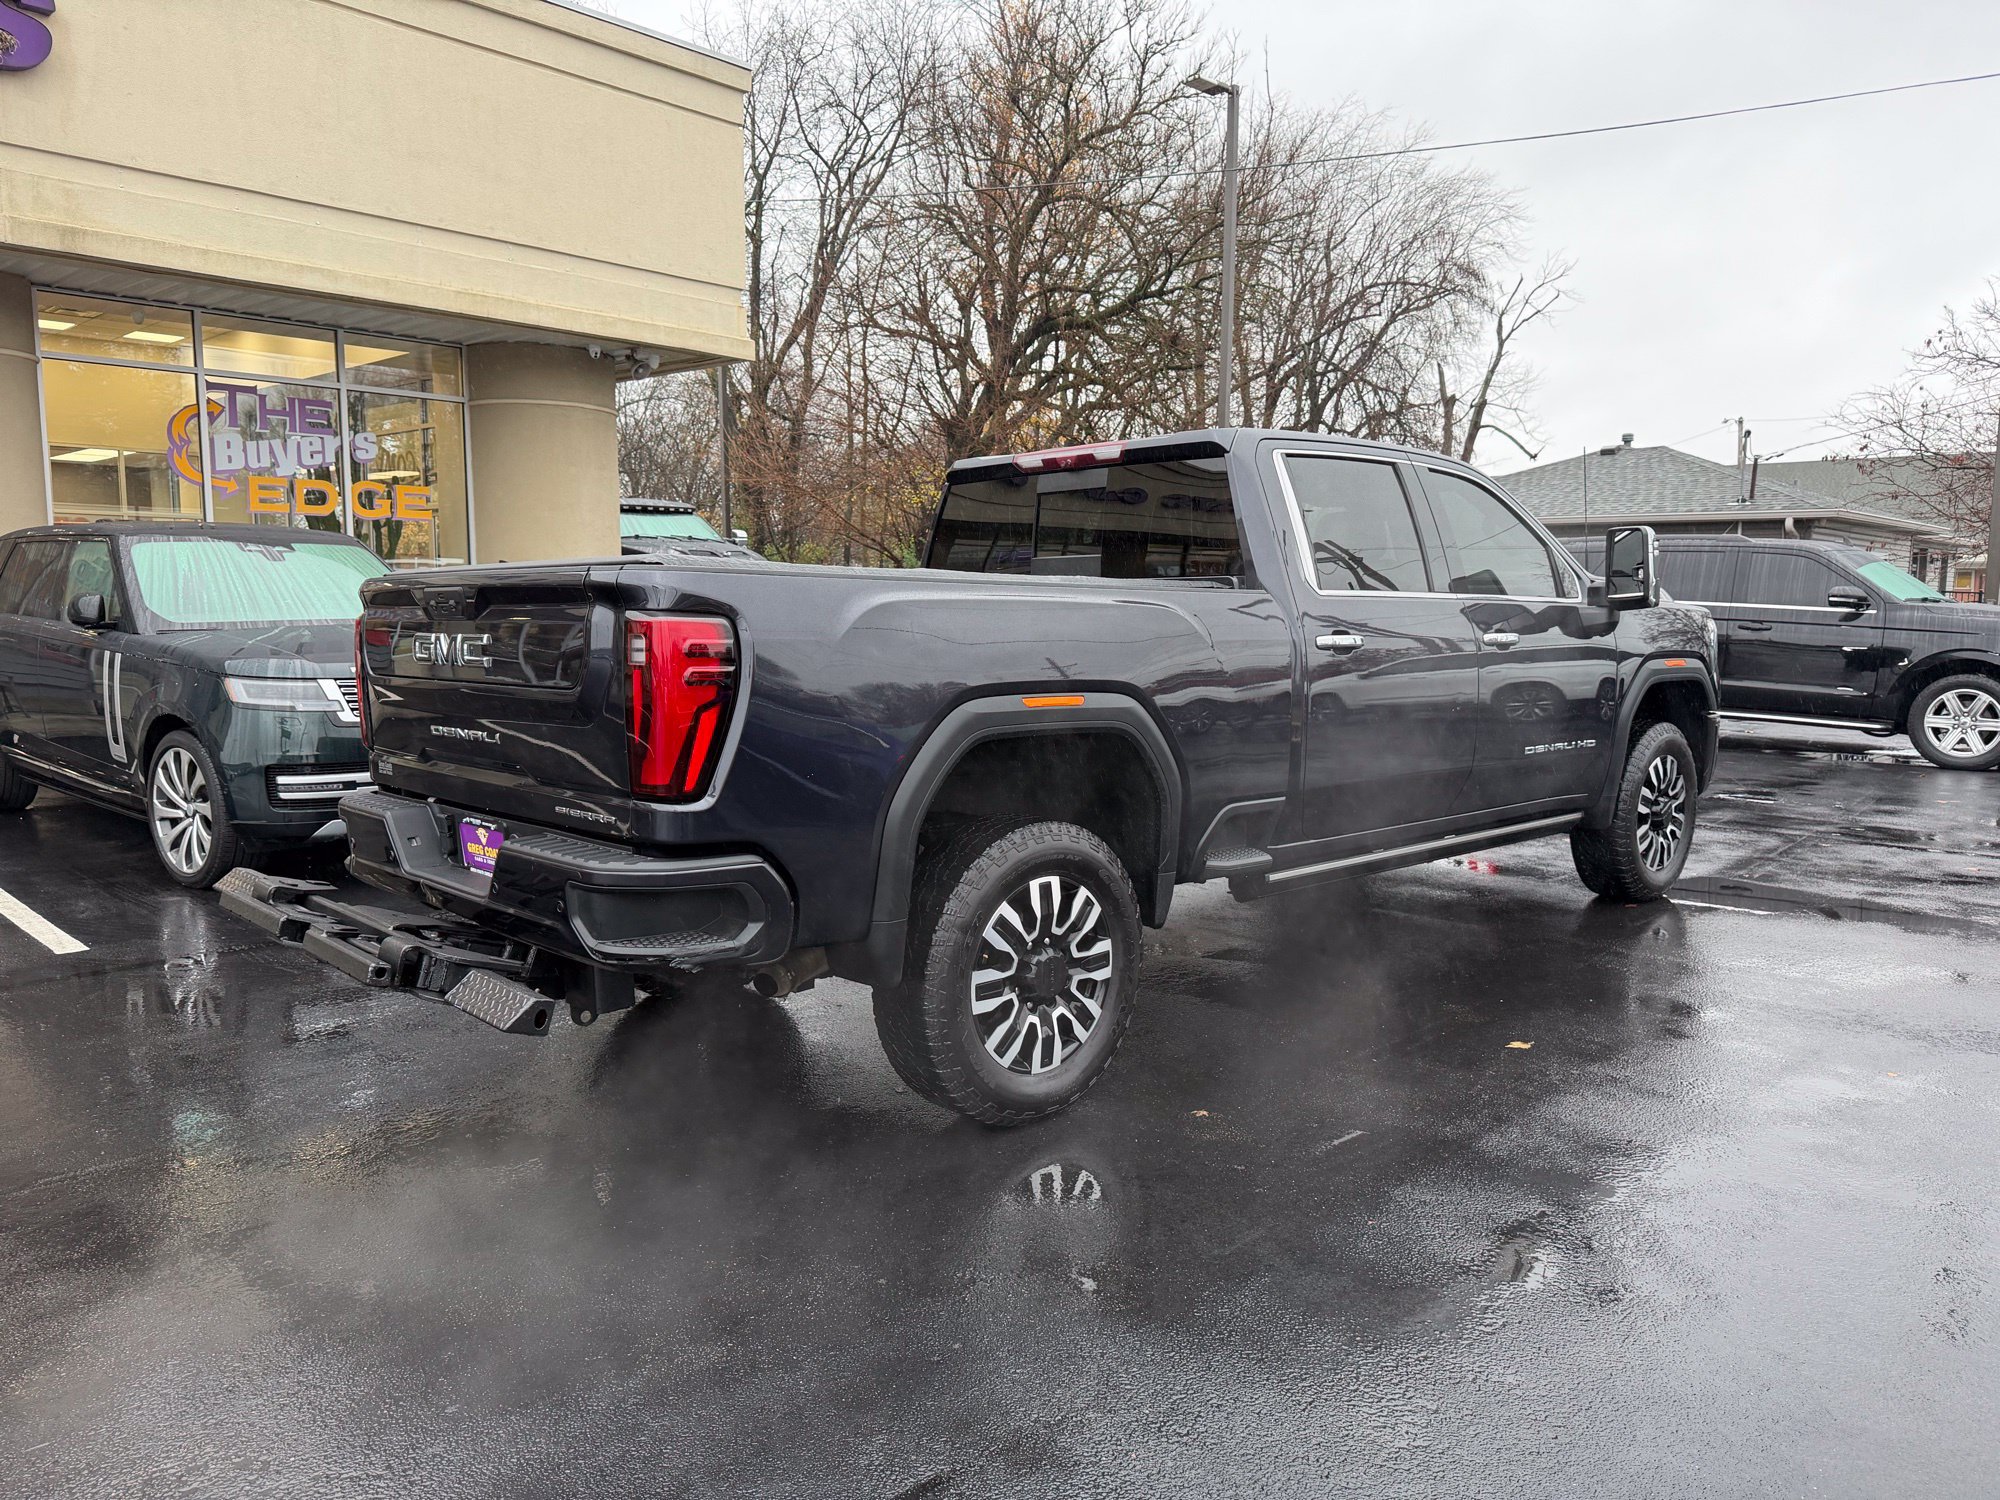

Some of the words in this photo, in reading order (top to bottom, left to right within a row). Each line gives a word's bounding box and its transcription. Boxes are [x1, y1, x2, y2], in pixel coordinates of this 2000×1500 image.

[205, 379, 334, 434] THE
[247, 475, 433, 521] EDGE
[412, 632, 492, 668] GMC
[430, 725, 500, 744] DENALI
[1524, 741, 1576, 755] DENALI
[1577, 739, 1596, 748] HD
[555, 805, 617, 824] SIERRA
[467, 842, 484, 855] GREG
